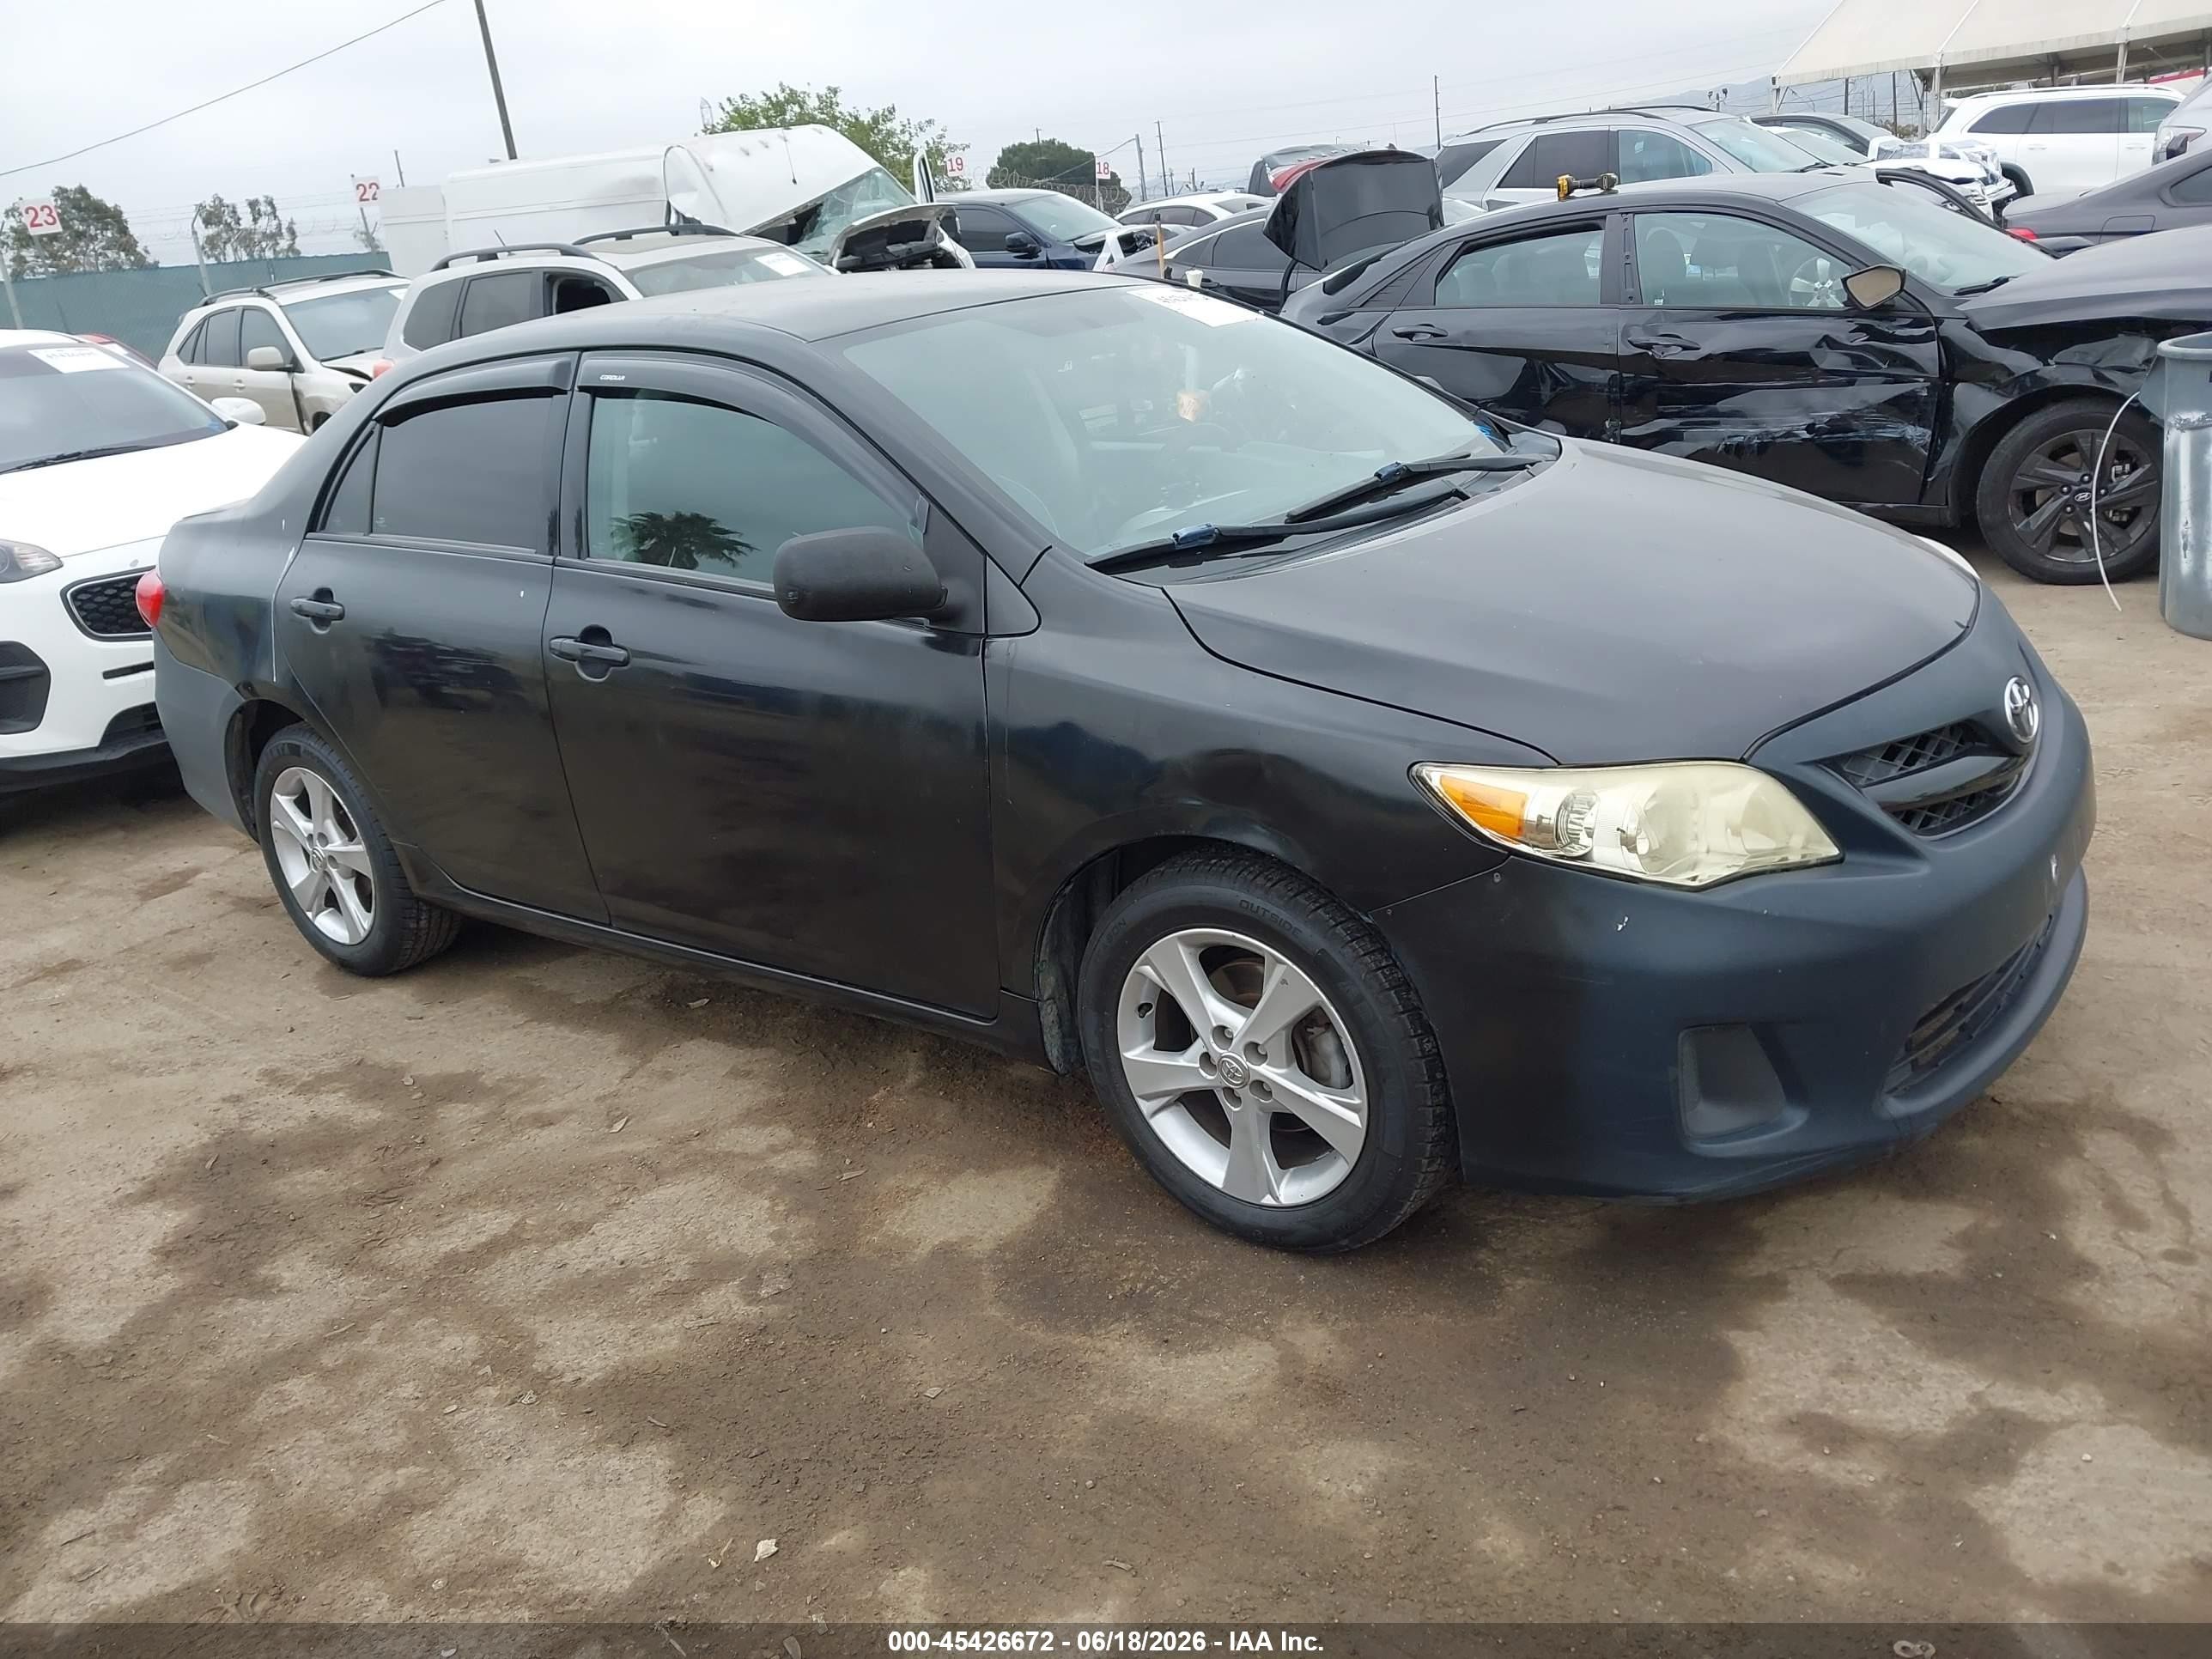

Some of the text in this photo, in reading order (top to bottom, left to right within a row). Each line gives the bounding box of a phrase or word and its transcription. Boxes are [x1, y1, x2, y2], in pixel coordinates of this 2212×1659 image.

[948, 156, 963, 172] 19
[1097, 161, 1110, 175] 18
[356, 182, 380, 202] 22
[24, 204, 57, 228] 23
[1238, 898, 1303, 939] OUTSIDE
